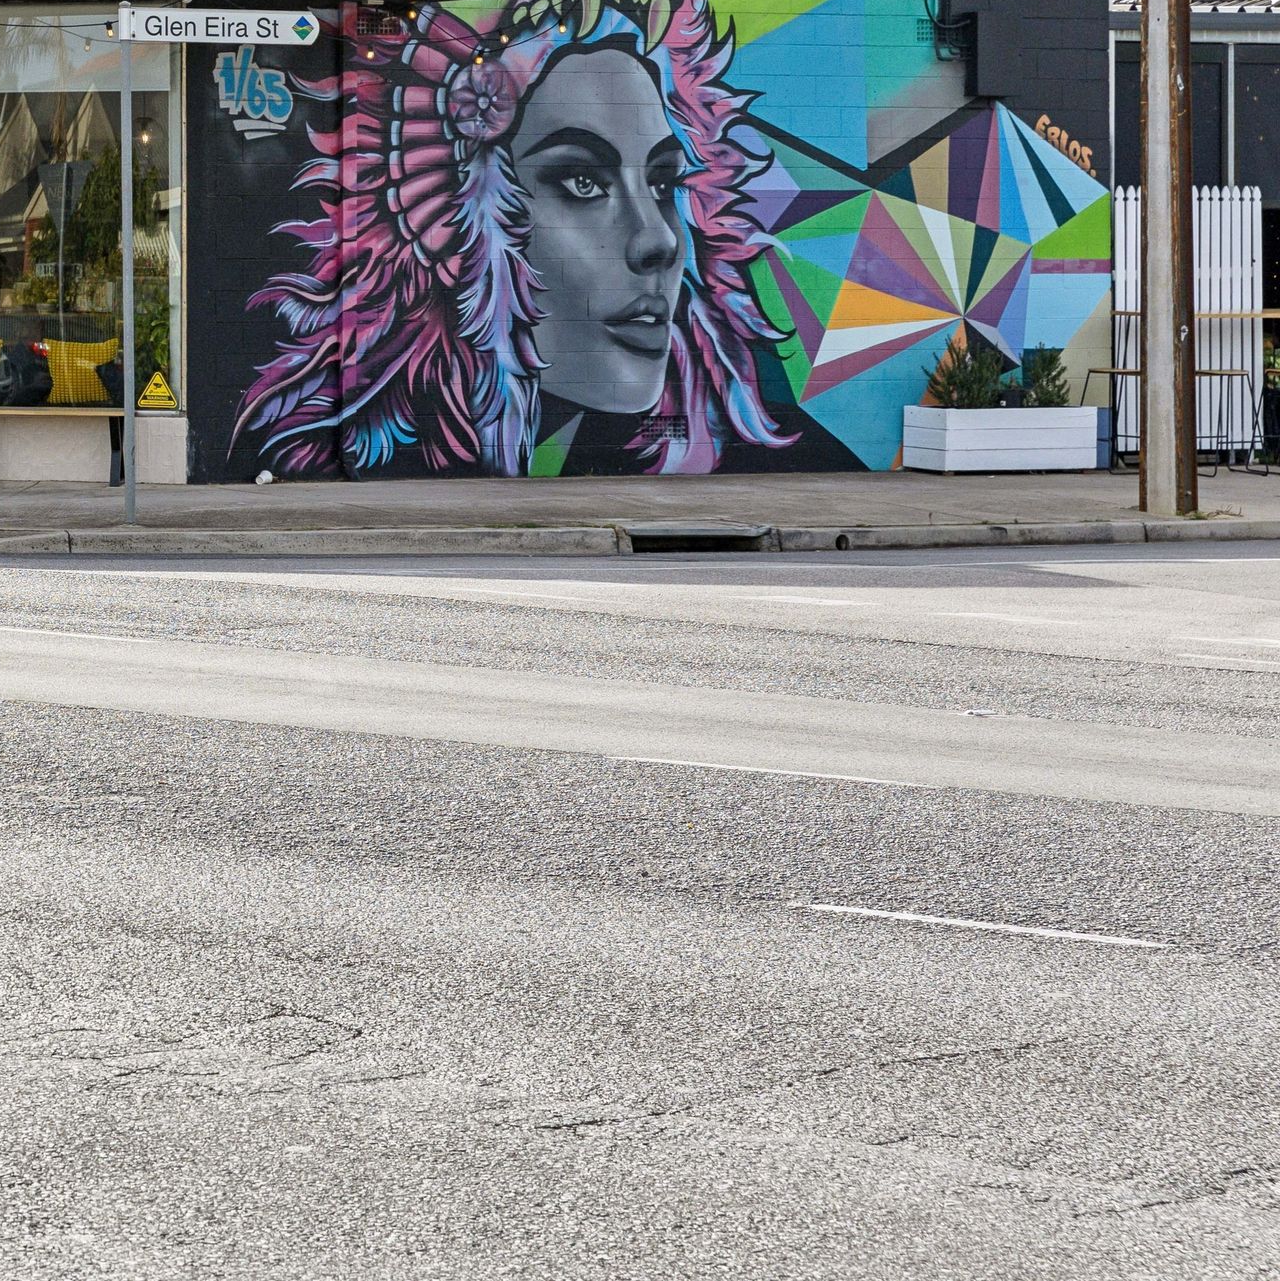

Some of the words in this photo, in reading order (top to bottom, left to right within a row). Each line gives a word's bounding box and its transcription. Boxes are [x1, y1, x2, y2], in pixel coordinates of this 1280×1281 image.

[145, 16, 196, 37] Glen
[205, 17, 248, 38] Eira
[256, 18, 279, 38] St
